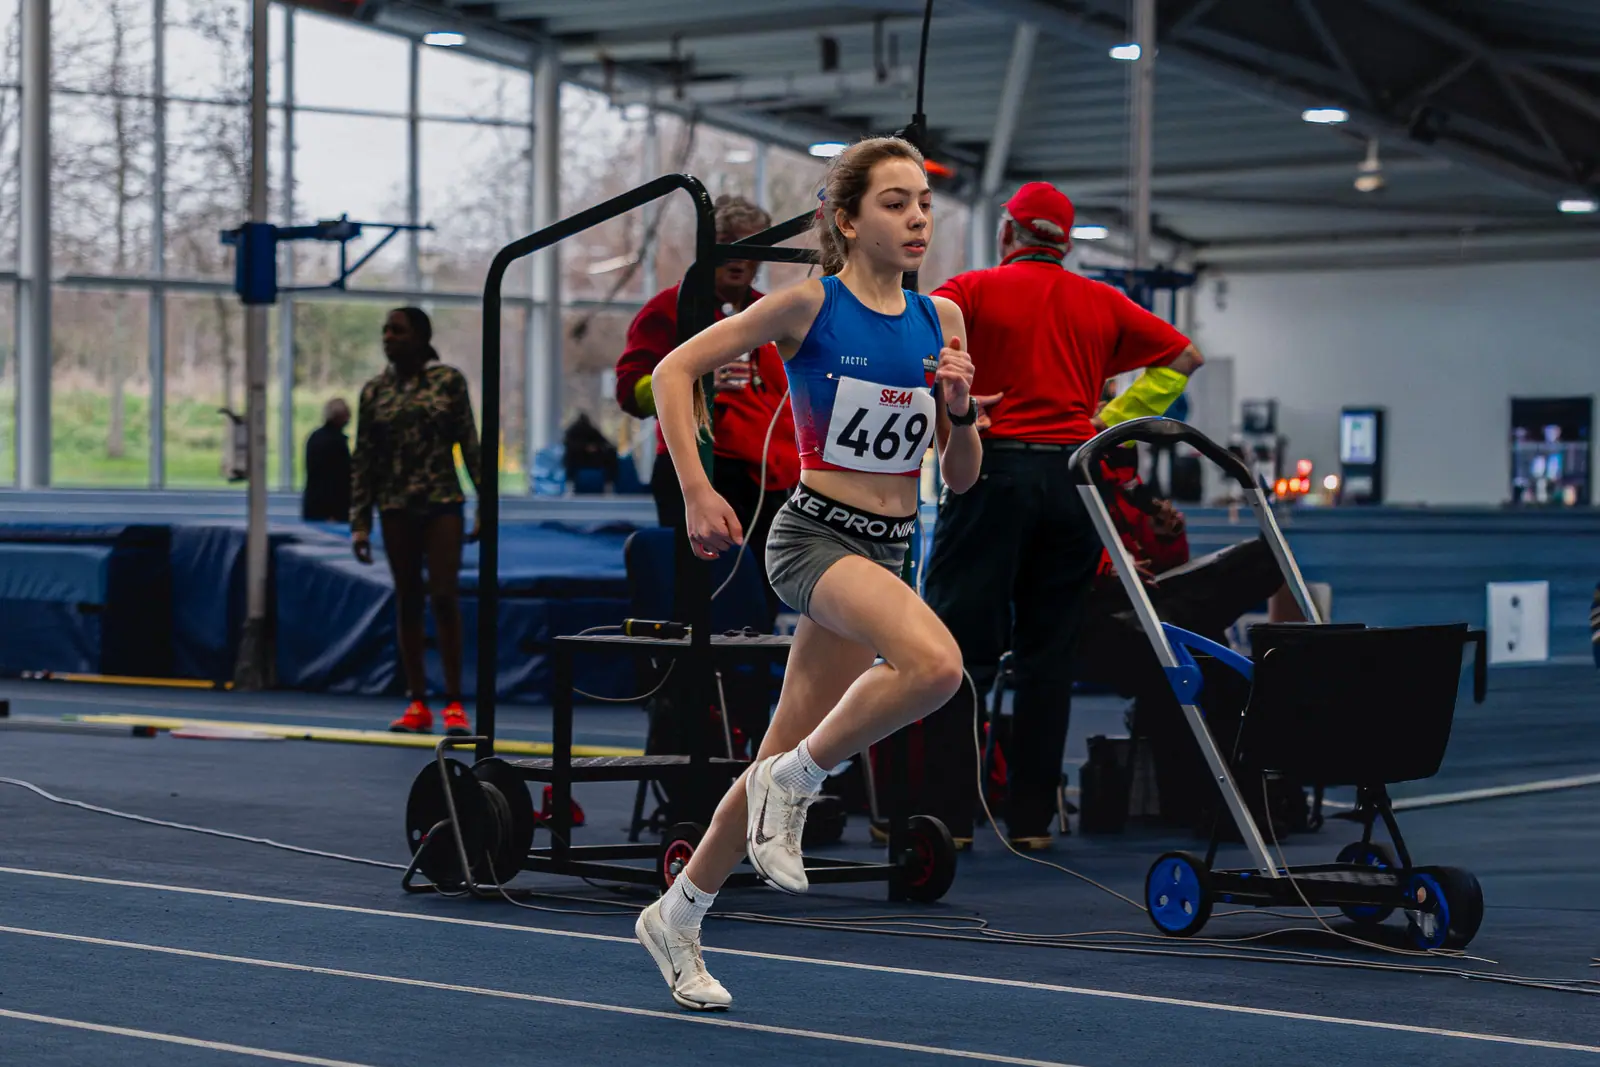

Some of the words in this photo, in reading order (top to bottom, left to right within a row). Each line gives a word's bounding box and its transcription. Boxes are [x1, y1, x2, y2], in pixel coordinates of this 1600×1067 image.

[840, 355, 868, 367] TACTIC
[836, 407, 928, 461] 469
[824, 506, 888, 537] PRO
[889, 519, 916, 538] NIK
